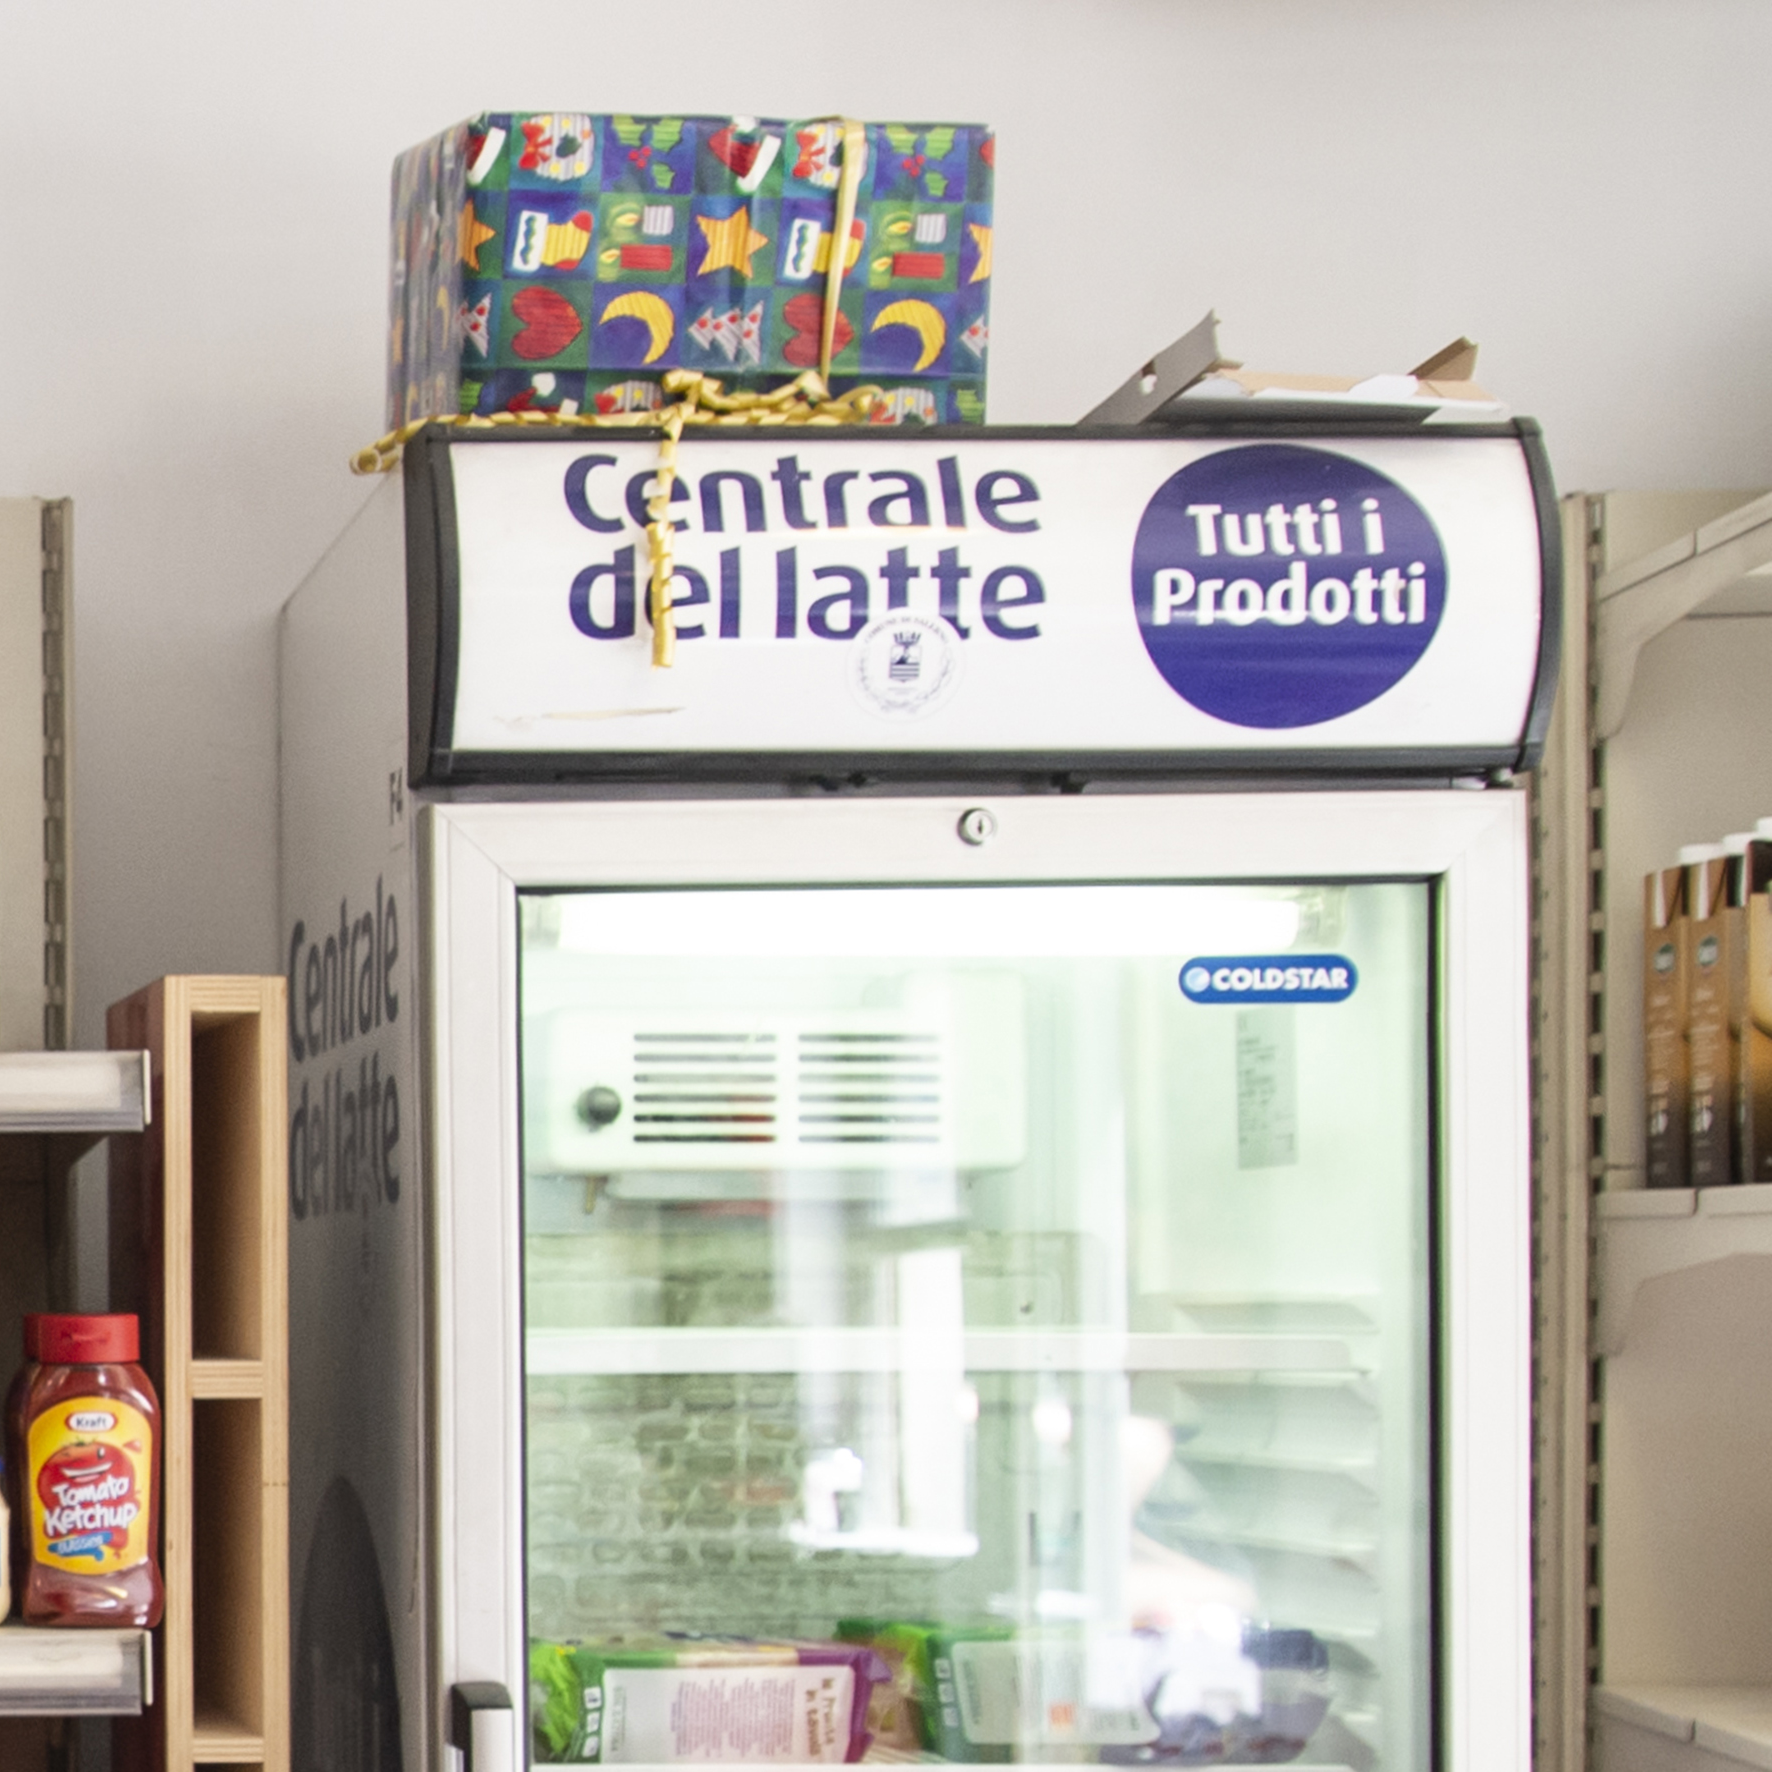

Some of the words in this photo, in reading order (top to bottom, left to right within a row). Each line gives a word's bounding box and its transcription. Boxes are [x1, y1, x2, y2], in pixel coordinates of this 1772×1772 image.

[563, 453, 1043, 534] Centrale
[1185, 498, 1343, 556] Tutti
[1362, 498, 1385, 555] i
[568, 544, 741, 642] del
[775, 544, 1047, 642] latte
[1152, 561, 1426, 627] Prodotti
[289, 873, 400, 1063] Centrale
[1211, 965, 1350, 992] COLDSTAR
[335, 1050, 401, 1215] latte
[75, 1414, 108, 1429] Kraft
[43, 1501, 139, 1537] Ketchup
[52, 1475, 130, 1508] Tomato
